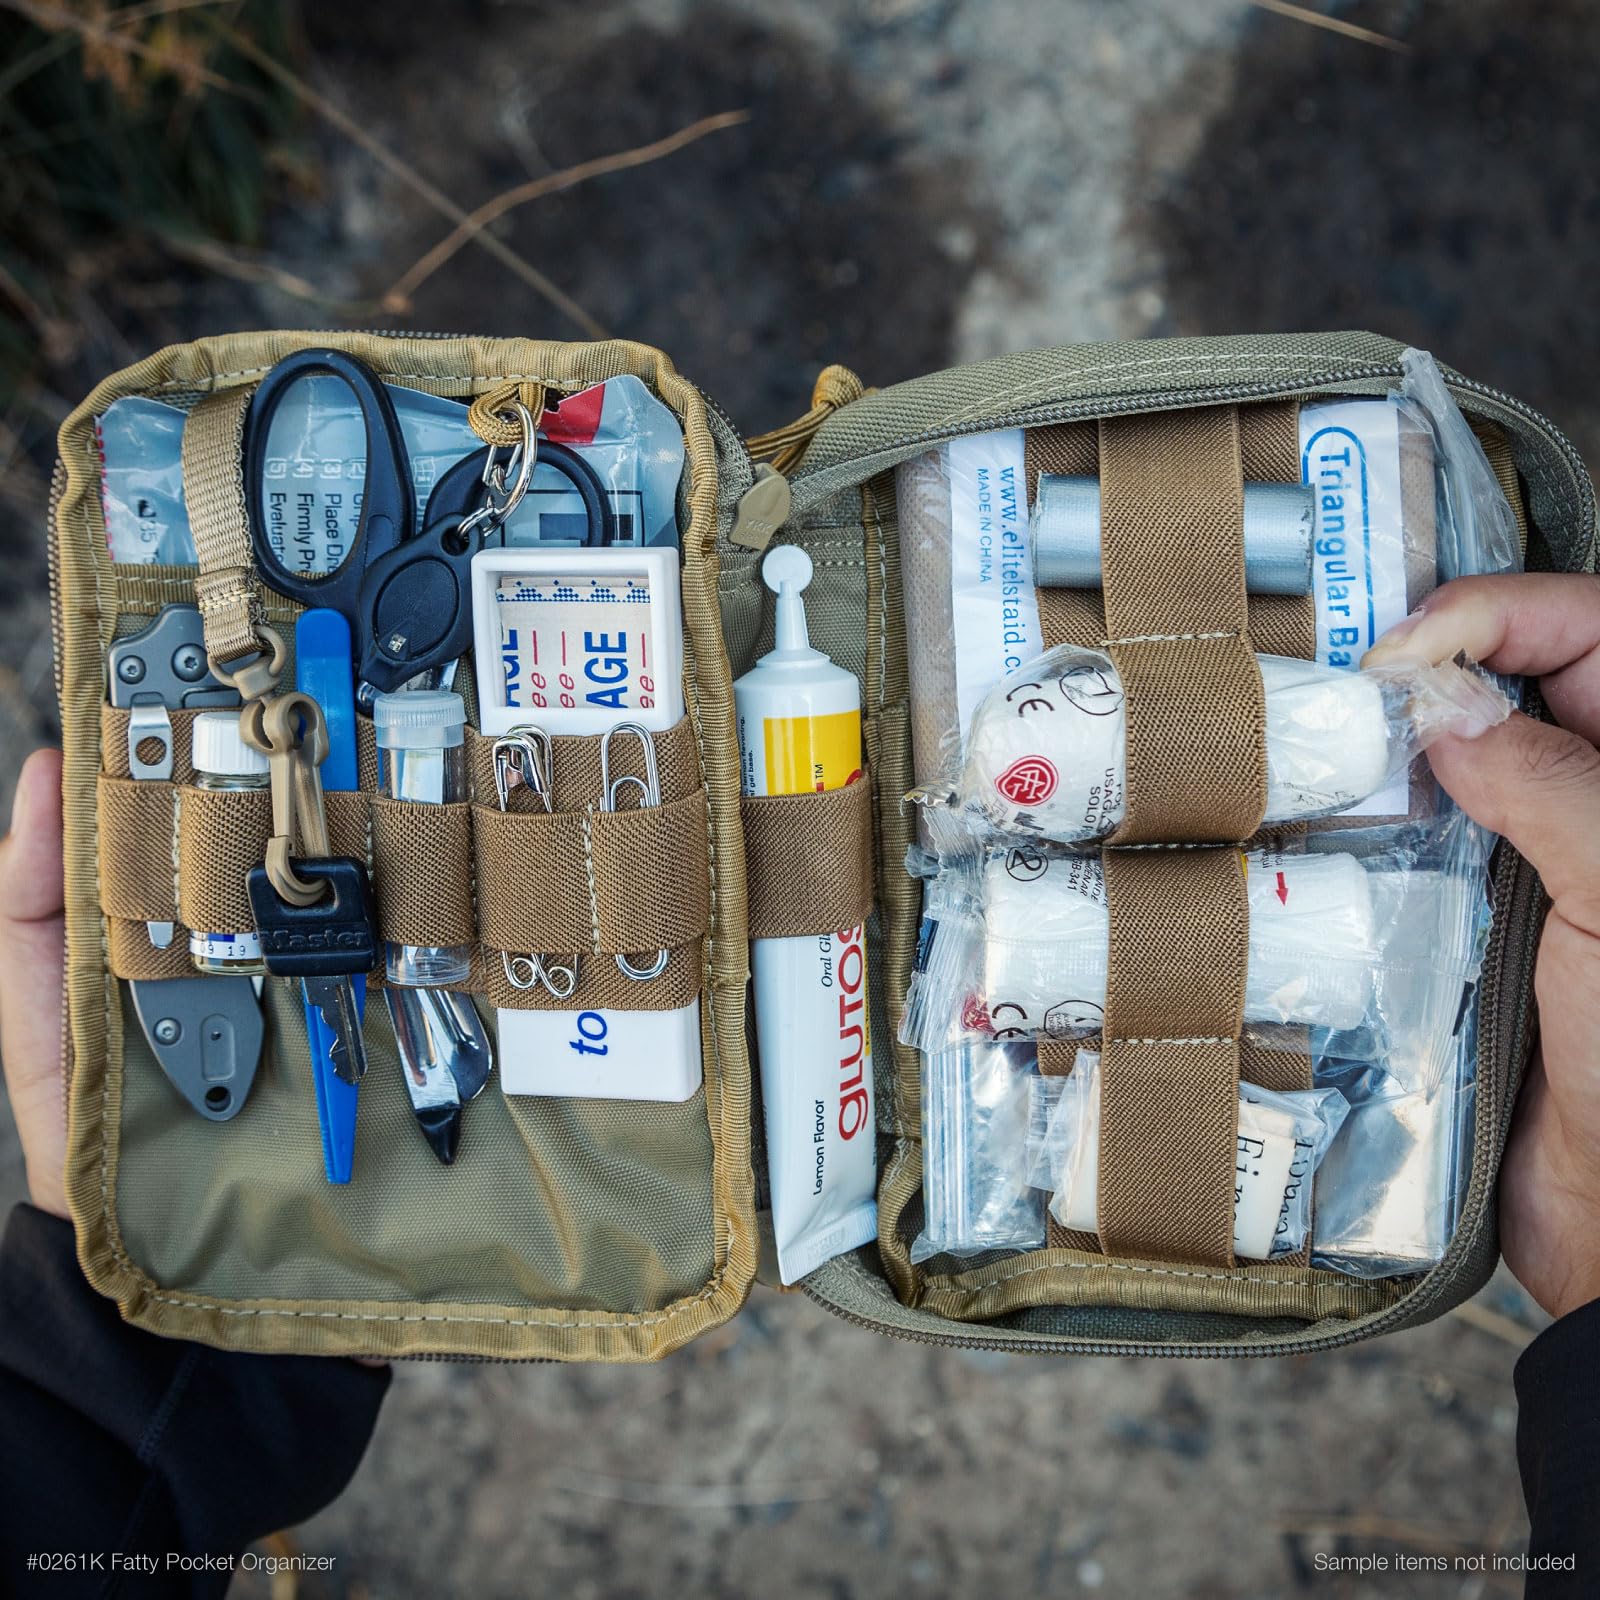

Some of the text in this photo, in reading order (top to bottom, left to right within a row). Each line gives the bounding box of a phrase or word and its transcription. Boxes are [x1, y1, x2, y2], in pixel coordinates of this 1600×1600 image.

[294, 493, 316, 545] Firmly
[325, 493, 342, 540] Place
[976, 468, 992, 583] MADE IN CHINA
[1316, 447, 1356, 617] Triangular
[815, 763, 823, 779] TM
[260, 929, 368, 950] Master
[820, 957, 833, 988] Oral
[569, 1011, 609, 1056] to
[813, 1099, 825, 1196] Lemon Flavor
